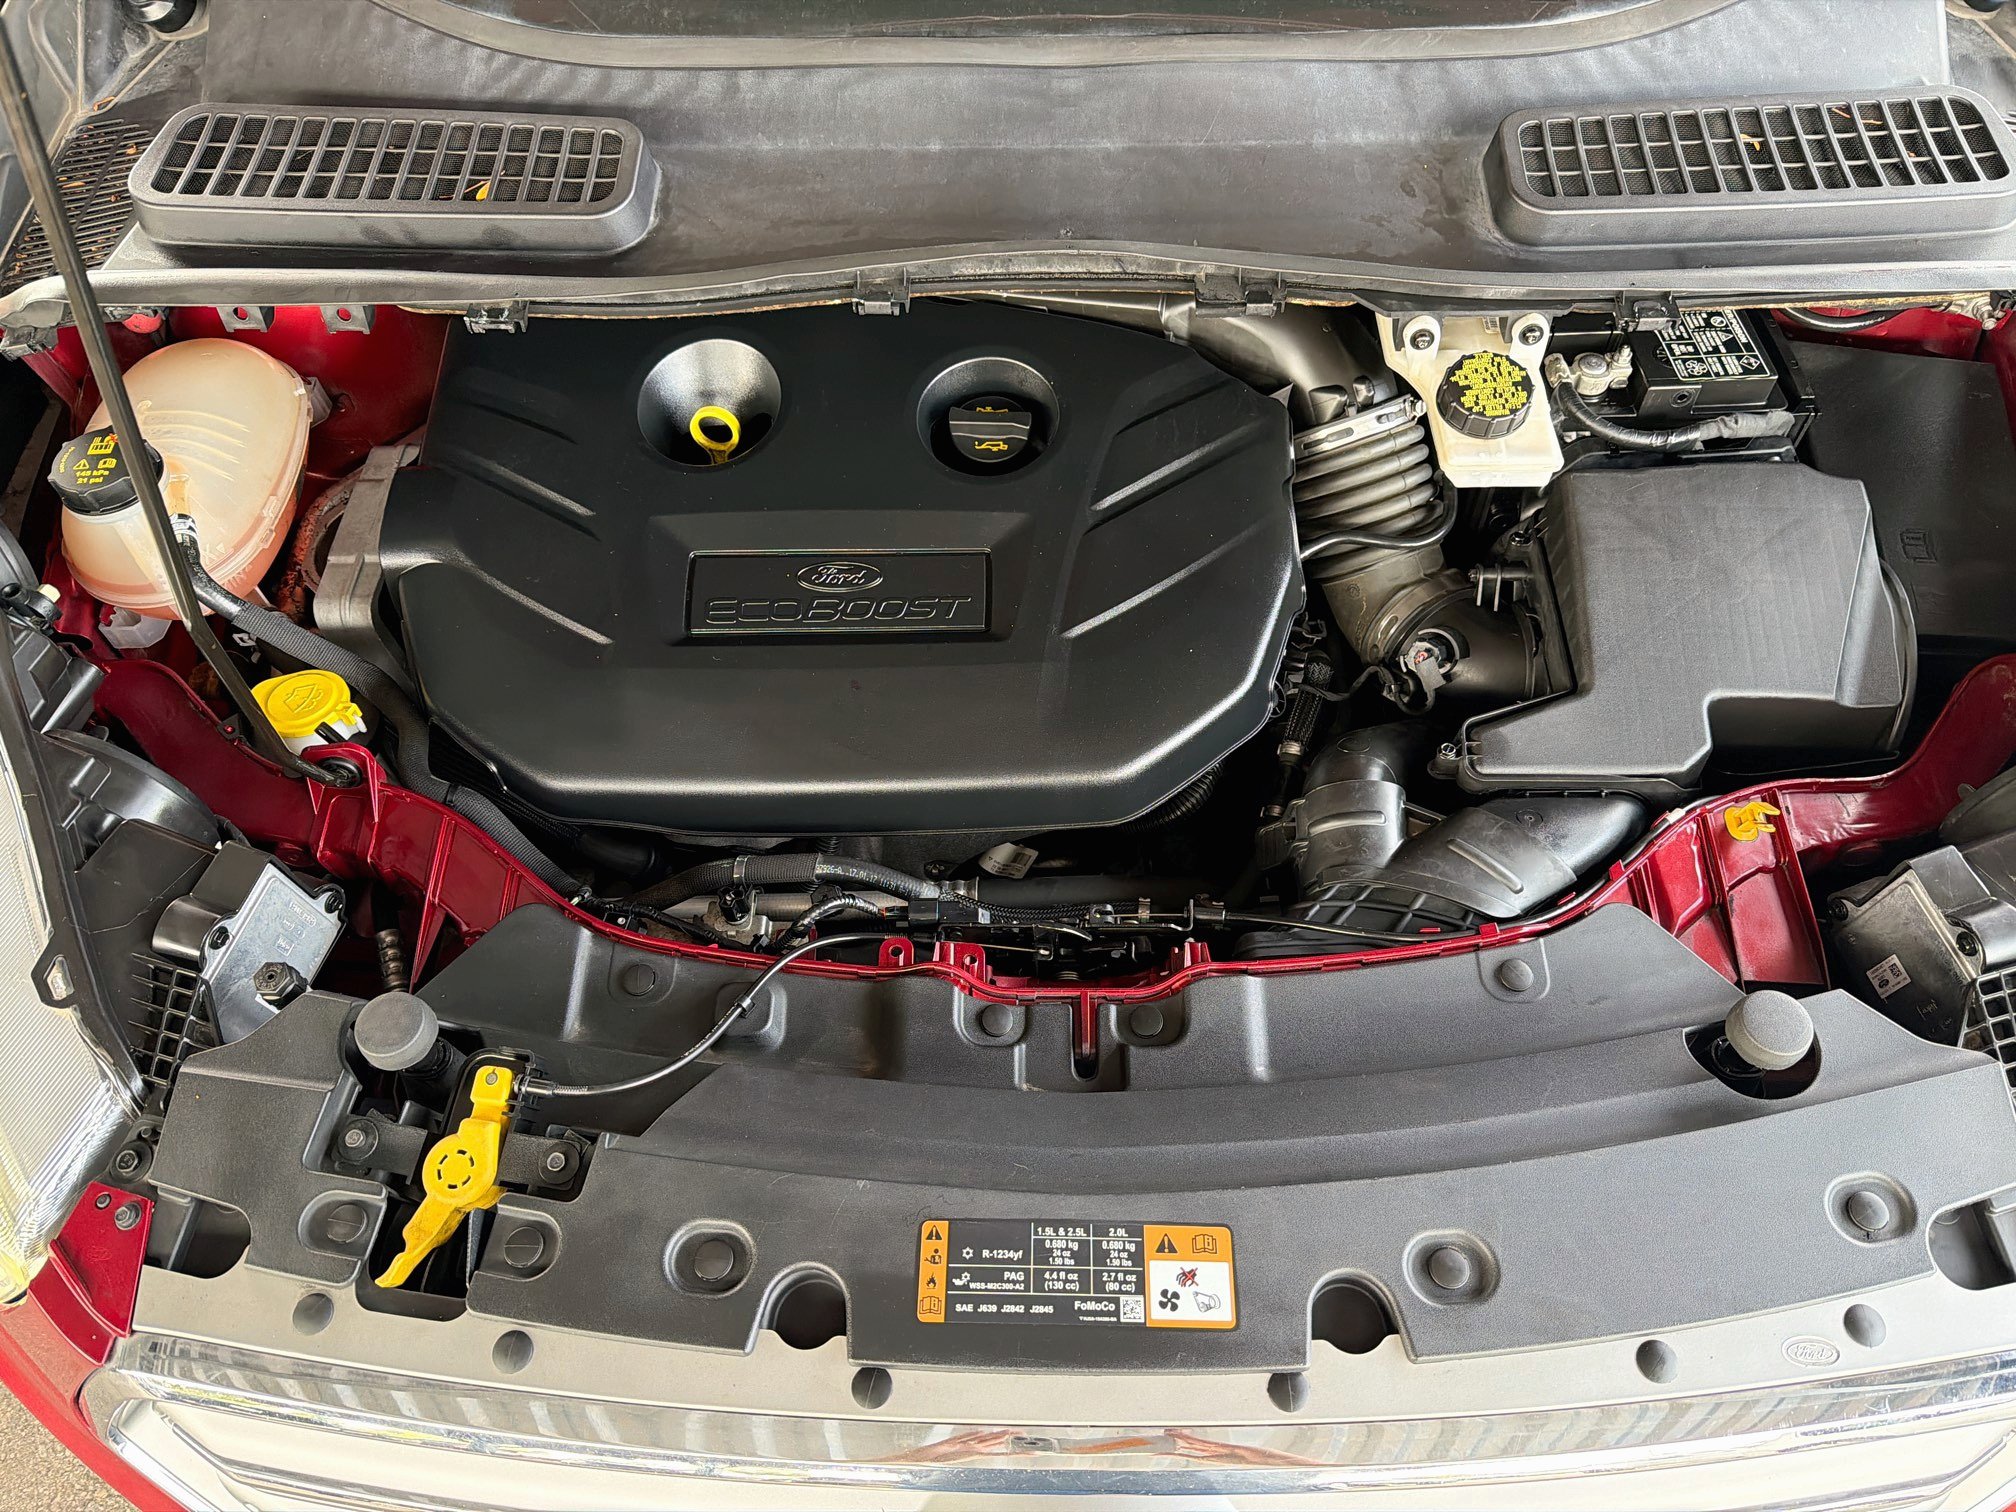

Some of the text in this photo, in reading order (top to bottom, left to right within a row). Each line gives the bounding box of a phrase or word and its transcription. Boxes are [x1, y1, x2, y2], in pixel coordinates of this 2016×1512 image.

[810, 564, 868, 586] Ford
[1037, 1227, 1087, 1237] 1.5L & 2.5L
[1109, 1228, 1129, 1237] 2.0L
[1045, 1240, 1079, 1251] 0.680 kg
[1102, 1241, 1136, 1252] 0.680 kg
[982, 1249, 1023, 1261] R-1234yf
[1052, 1249, 1061, 1257] 24
[1110, 1250, 1118, 1258] 24
[1064, 1258, 1075, 1266] lbs
[1122, 1259, 1132, 1267] lbs
[1004, 1271, 1024, 1281] PAG
[1044, 1271, 1078, 1281] 4.4 fl oz
[1102, 1272, 1136, 1282] 2.7 fl oz
[1044, 1281, 1080, 1292] (130 cc)
[1106, 1282, 1135, 1293] (80 cc)
[955, 1304, 1054, 1314] SAE J639 J2842 J2845
[1074, 1301, 1116, 1312] FoMoCo
